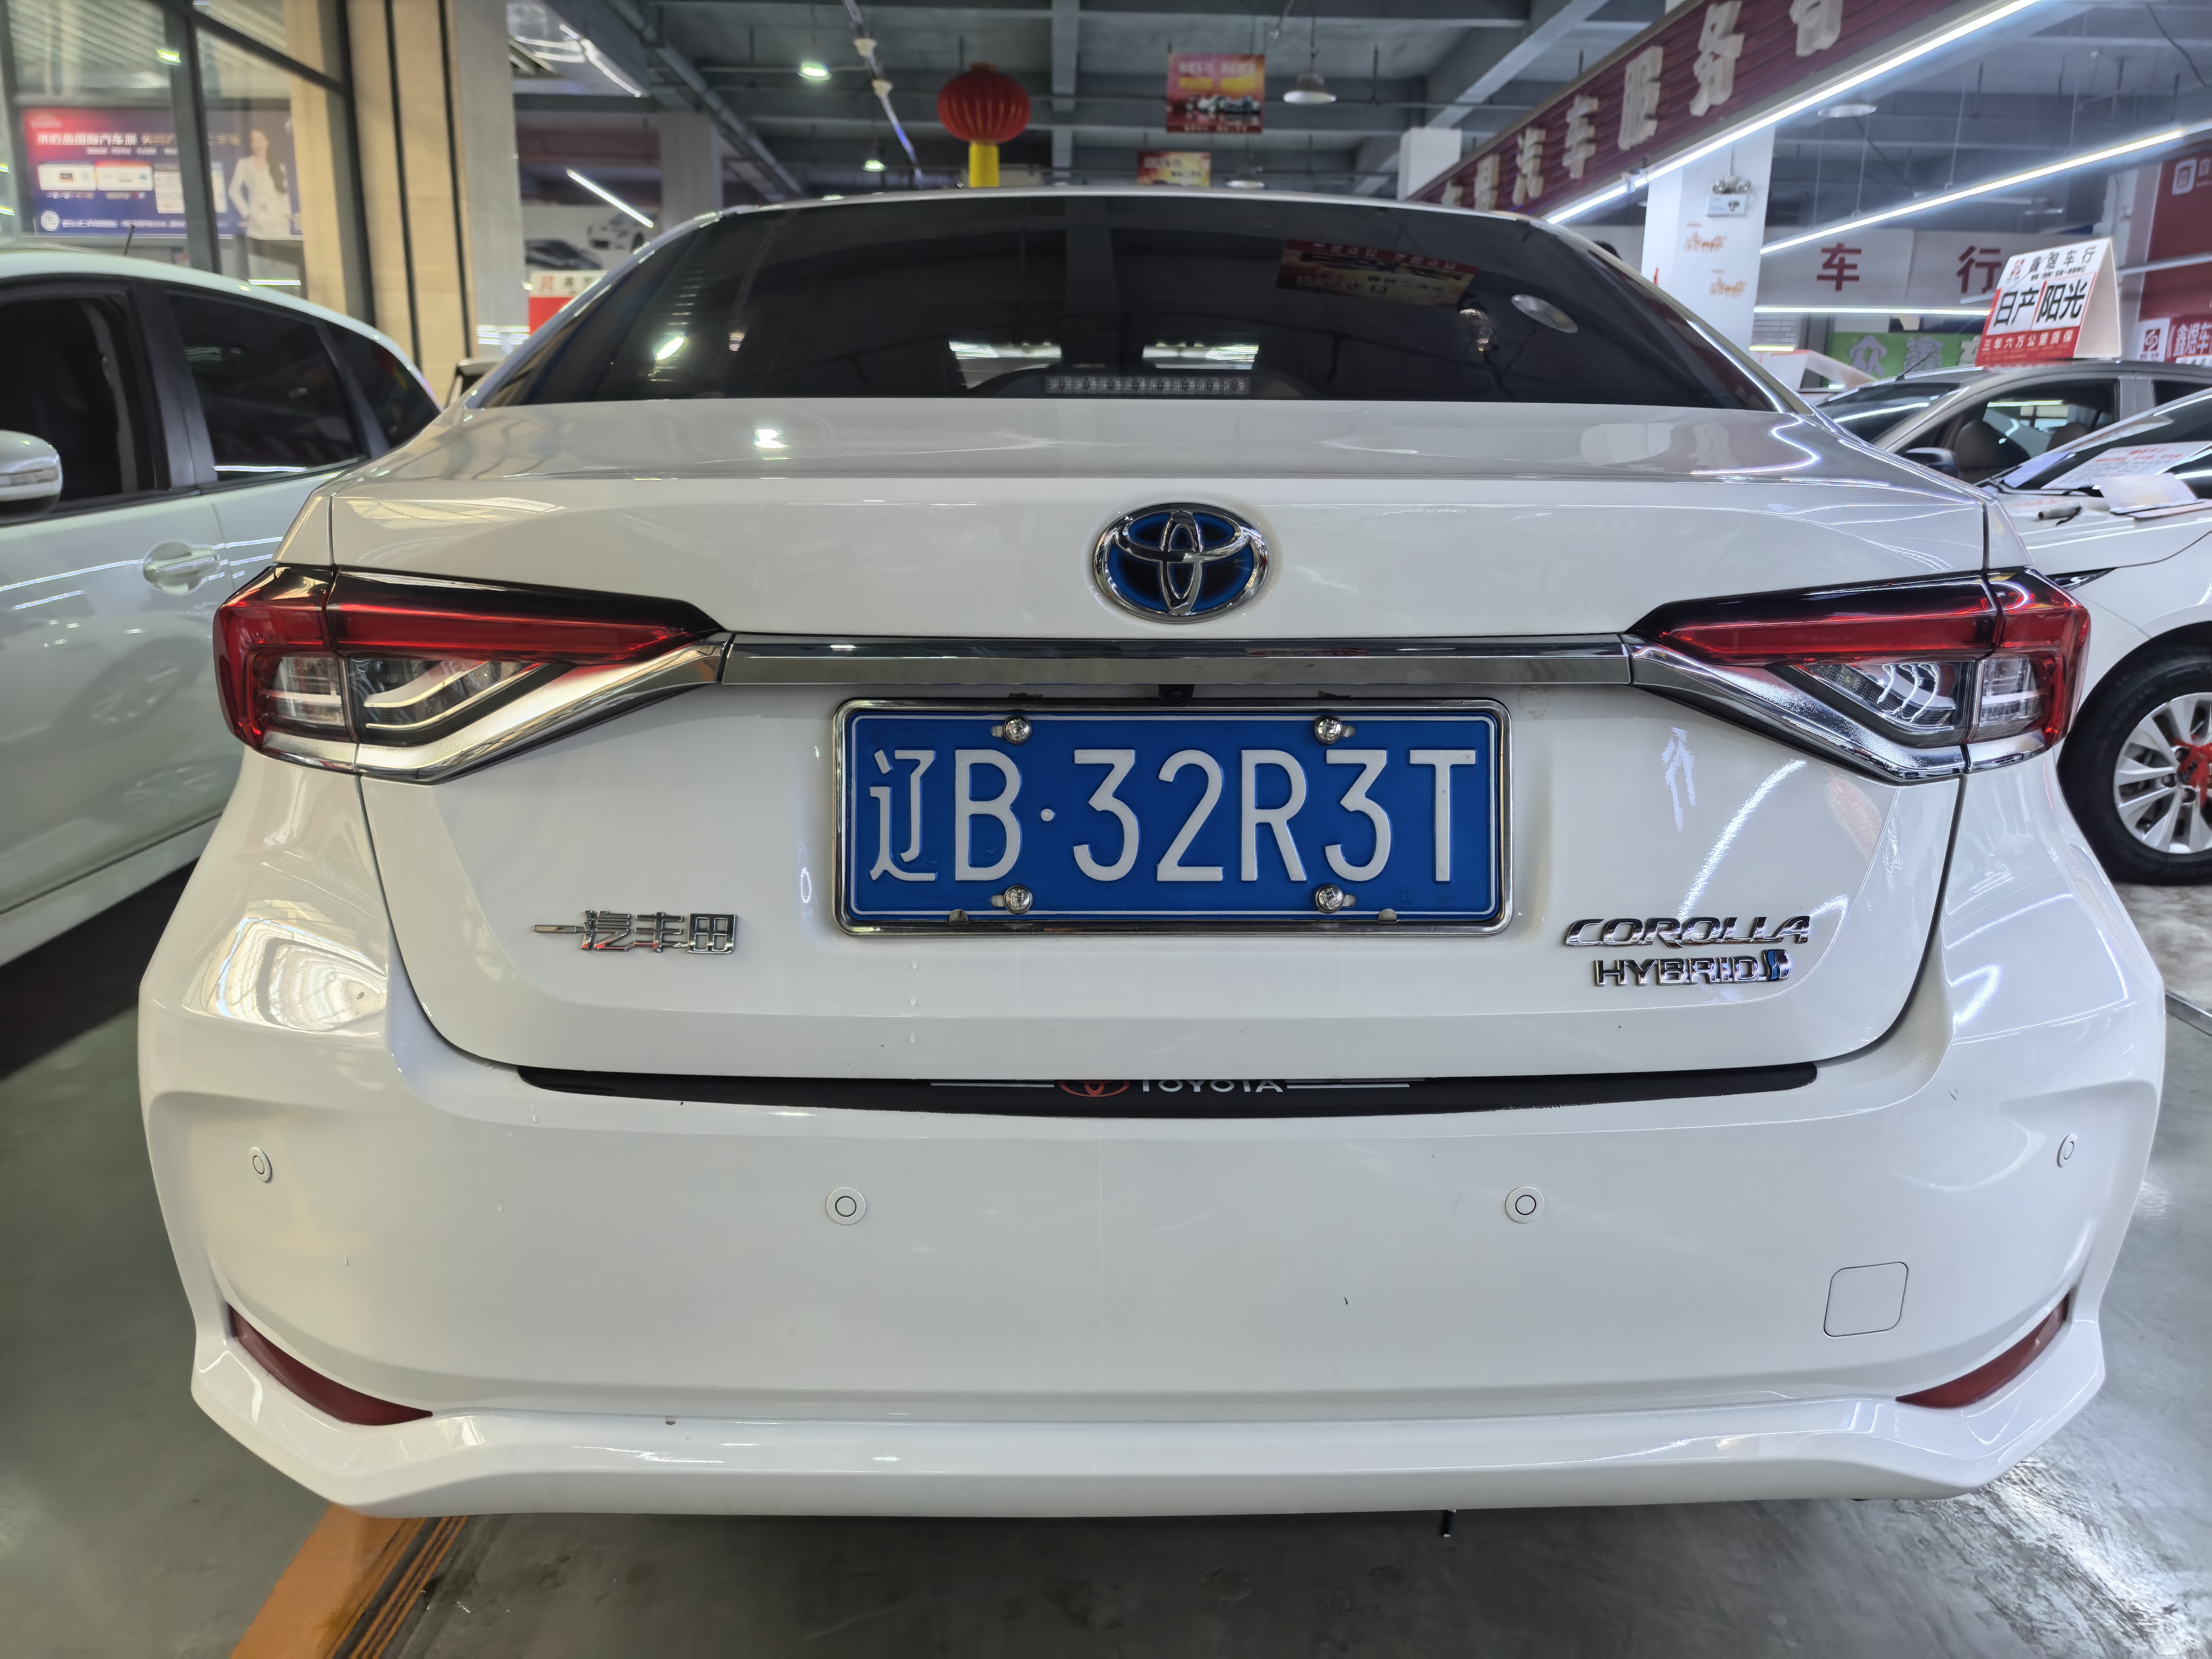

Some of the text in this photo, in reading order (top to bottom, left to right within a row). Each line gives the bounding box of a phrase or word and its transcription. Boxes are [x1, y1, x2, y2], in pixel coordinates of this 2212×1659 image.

[1993, 278, 2088, 327] 日产 阳光
[869, 748, 1477, 882] 辽B·32R3T
[532, 909, 738, 954] 一汽丰田
[1564, 915, 1810, 949] COROLLA
[1593, 955, 1760, 987] HYBRID
